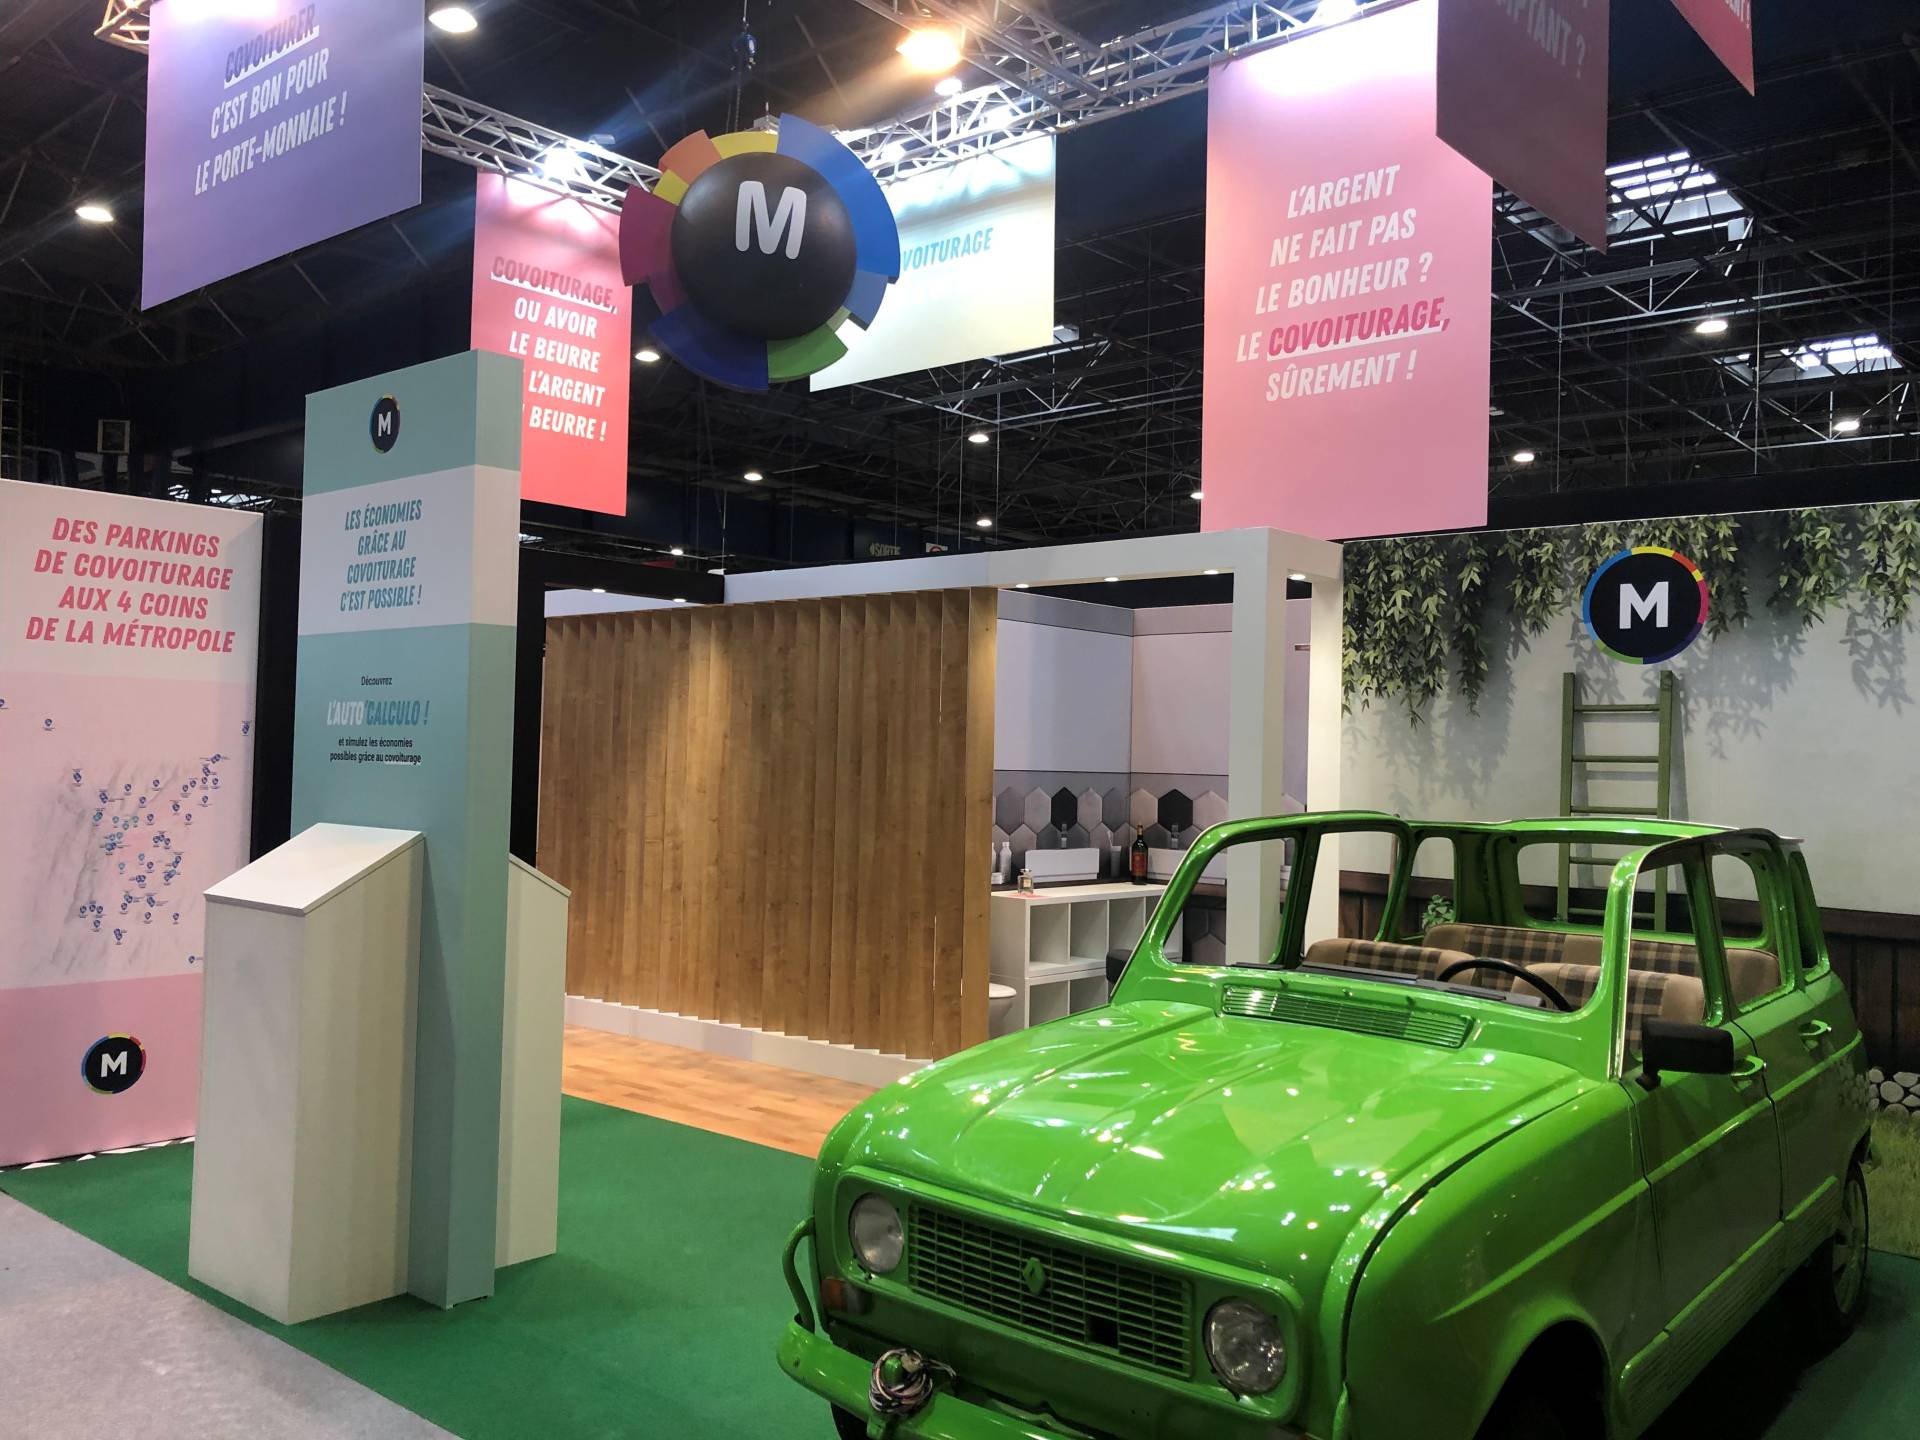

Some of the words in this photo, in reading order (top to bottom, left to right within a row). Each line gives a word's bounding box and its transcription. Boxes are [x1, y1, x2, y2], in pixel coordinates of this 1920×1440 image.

[225, 3, 317, 83] COVOITURER
[211, 91, 249, 139] C'EST
[250, 72, 283, 120] BON
[285, 48, 330, 100] POUR
[195, 159, 211, 196] LE
[212, 96, 337, 187] PORTE-MONNAIE
[340, 91, 348, 127] !
[1287, 164, 1401, 219] L'ARGENT
[735, 181, 807, 260] M
[1269, 233, 1304, 267] NE
[1309, 219, 1363, 259] FAIT
[1367, 207, 1417, 246] PAS
[492, 256, 616, 314] COVOITURAGE,
[1255, 283, 1282, 315] LE
[1287, 257, 1410, 308] BONHEUR
[1419, 252, 1433, 283] ?
[514, 297, 541, 323] OU
[544, 305, 598, 339] AVOIR
[1236, 331, 1263, 363] LE
[1268, 296, 1450, 357] COVOITURAGE,
[509, 331, 531, 356] LE
[534, 336, 601, 373] BEURRE
[528, 370, 606, 408] L'ARGENT
[1265, 352, 1401, 402] SÛREMENT
[1405, 349, 1417, 381] !
[378, 411, 392, 437] M
[529, 405, 597, 440] BEURRE
[599, 421, 607, 442] !
[344, 509, 362, 531] LES
[363, 499, 423, 529] ÉCONOMIES
[52, 517, 99, 545] DES
[105, 523, 220, 558] PARKINGS
[357, 529, 391, 556] GRÂCE
[391, 529, 407, 552] AU
[34, 549, 68, 574] DE
[73, 552, 234, 591] COVOITURAGE
[347, 556, 417, 584] COVOITURAGE
[58, 586, 112, 612] AUX
[116, 590, 132, 614] 4
[139, 592, 209, 620] COINS
[340, 589, 366, 612] C'EST
[367, 584, 415, 609] POSSIBLE
[416, 583, 422, 605] !
[1619, 581, 1669, 630] M
[25, 616, 60, 641] DE
[65, 619, 94, 645] LA
[103, 618, 236, 652] MÉTROPOLE
[361, 675, 393, 686] Découvrez
[424, 700, 430, 726] !
[330, 750, 357, 762] possibles
[358, 752, 375, 763] grâce
[376, 753, 384, 762] au
[385, 752, 422, 765] covoiturage
[338, 738, 345, 747] et
[345, 736, 368, 747] simulez
[369, 736, 378, 747] les
[379, 737, 413, 748] économies
[100, 1051, 128, 1078] M
